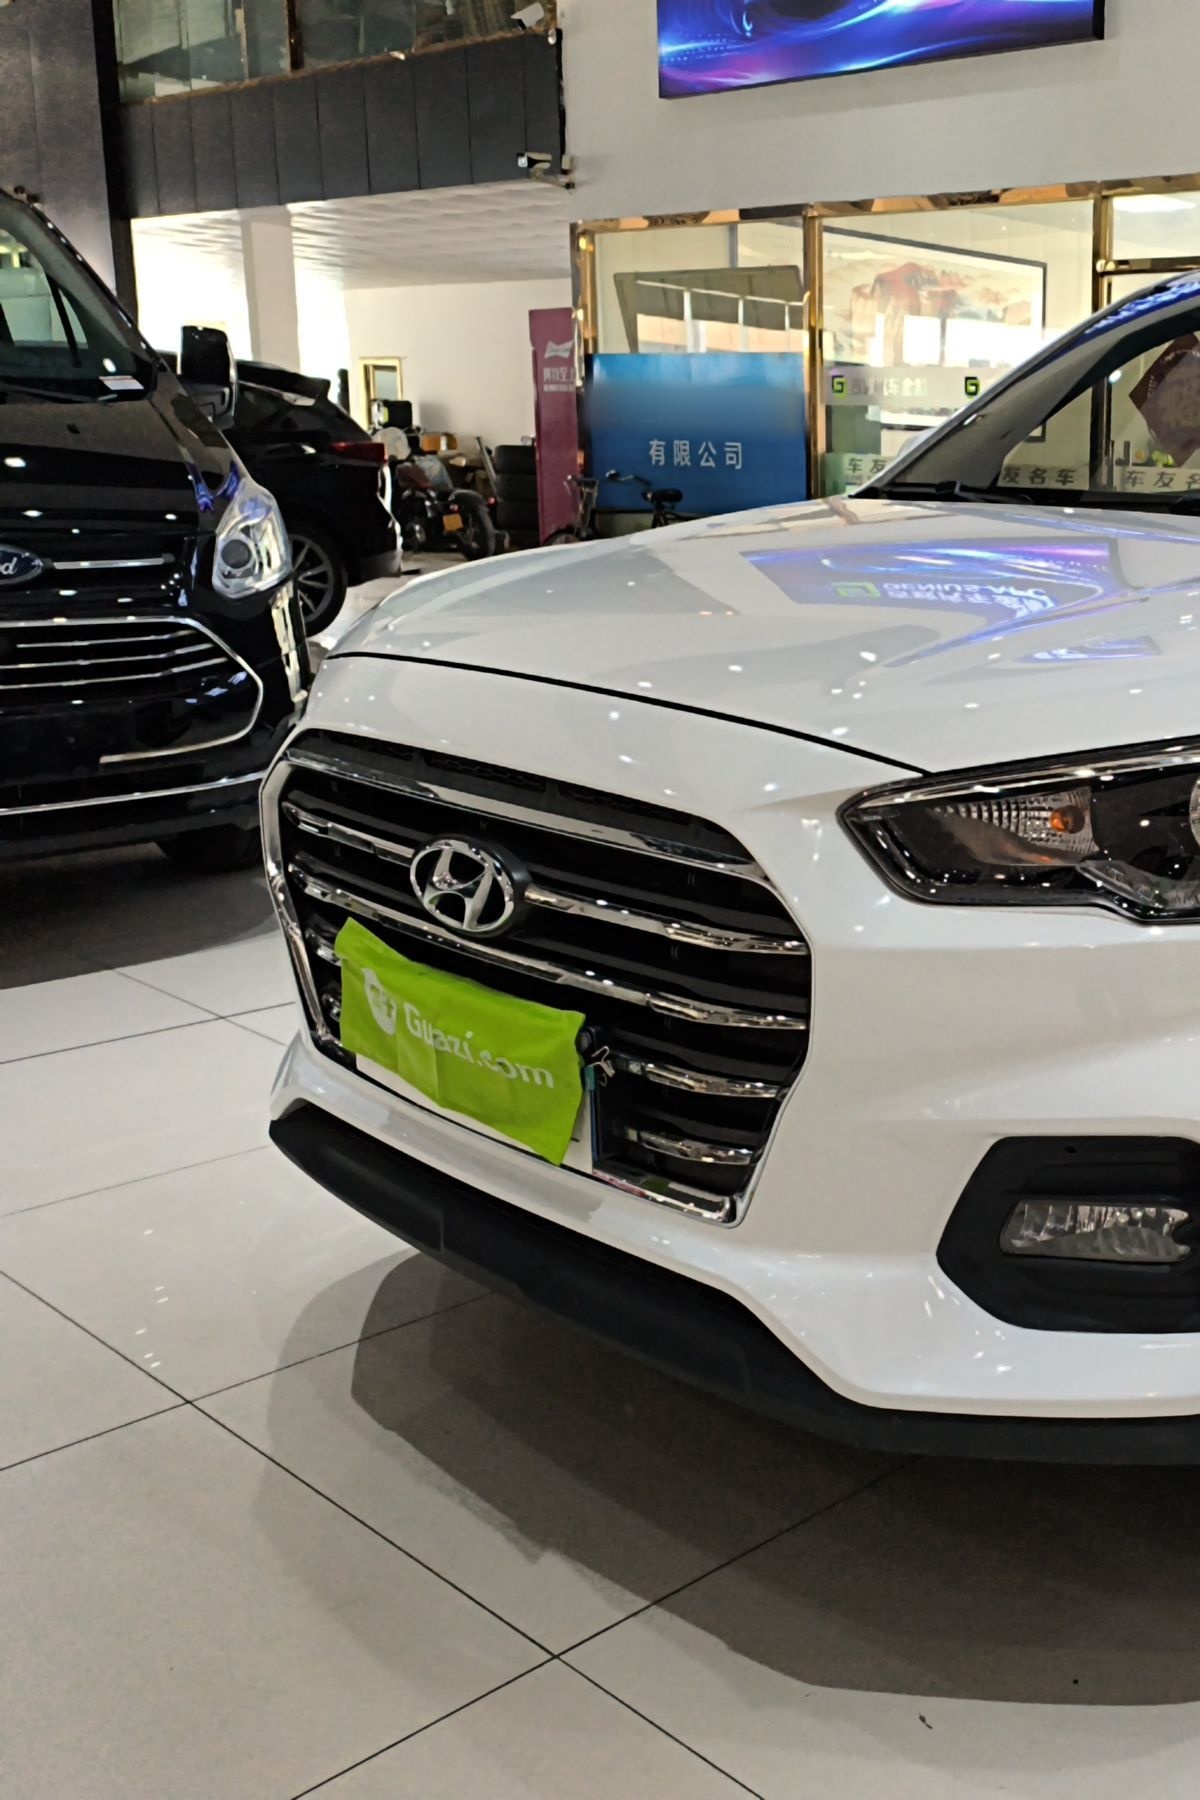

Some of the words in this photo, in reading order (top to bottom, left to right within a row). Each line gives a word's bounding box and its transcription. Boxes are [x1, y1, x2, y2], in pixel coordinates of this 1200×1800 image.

[648, 438, 742, 469] 有限公司
[1002, 468, 1076, 485] 友名车
